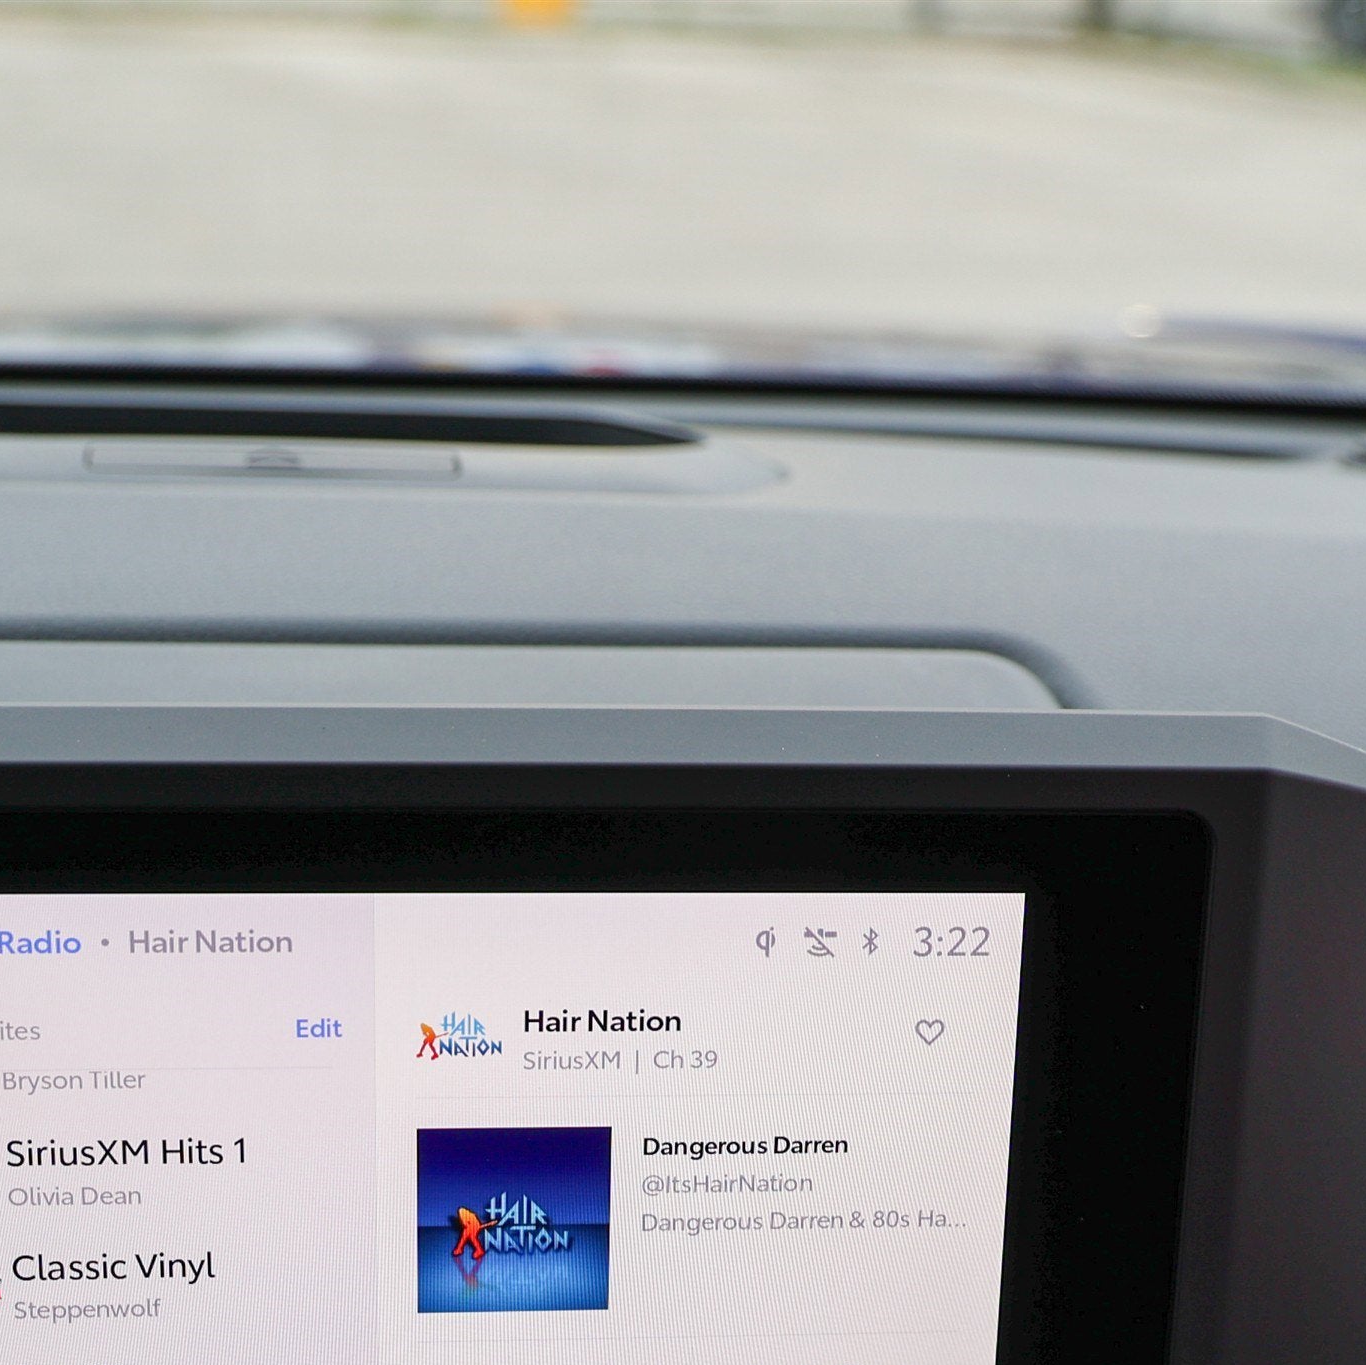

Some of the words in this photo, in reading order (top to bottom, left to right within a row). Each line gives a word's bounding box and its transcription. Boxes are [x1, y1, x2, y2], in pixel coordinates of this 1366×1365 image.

[129, 930, 189, 954] Hair
[195, 930, 294, 954] Nation
[913, 926, 992, 957] 3:22
[295, 1018, 343, 1039] Edit
[440, 1011, 485, 1036] HAIR
[523, 1010, 581, 1032] Hair
[587, 1010, 683, 1032] Nation
[439, 1036, 503, 1057] NATION
[523, 1050, 622, 1071] SiriusXM
[653, 1050, 684, 1070] Ch
[691, 1050, 718, 1069] 39
[2, 1071, 83, 1096] Bryson
[89, 1070, 146, 1091] Tiller
[6, 1139, 150, 1168] SiriusXM
[162, 1138, 224, 1165] Hits
[233, 1138, 247, 1164] 1
[642, 1137, 768, 1161] Dangerous
[774, 1136, 849, 1156] Darren
[8, 1187, 74, 1207] Olivia
[81, 1187, 142, 1207] Dean
[642, 1173, 814, 1196] @ItsHairNation
[485, 1191, 548, 1226] HAIR
[641, 1213, 763, 1237] Dangerous
[769, 1211, 844, 1232] Darren
[848, 1212, 865, 1230] &
[872, 1211, 911, 1230] 80s
[484, 1225, 570, 1255] NATION
[12, 1253, 127, 1282] Classic
[135, 1252, 216, 1285] Vinyl
[14, 1298, 161, 1323] Steppenwolf
